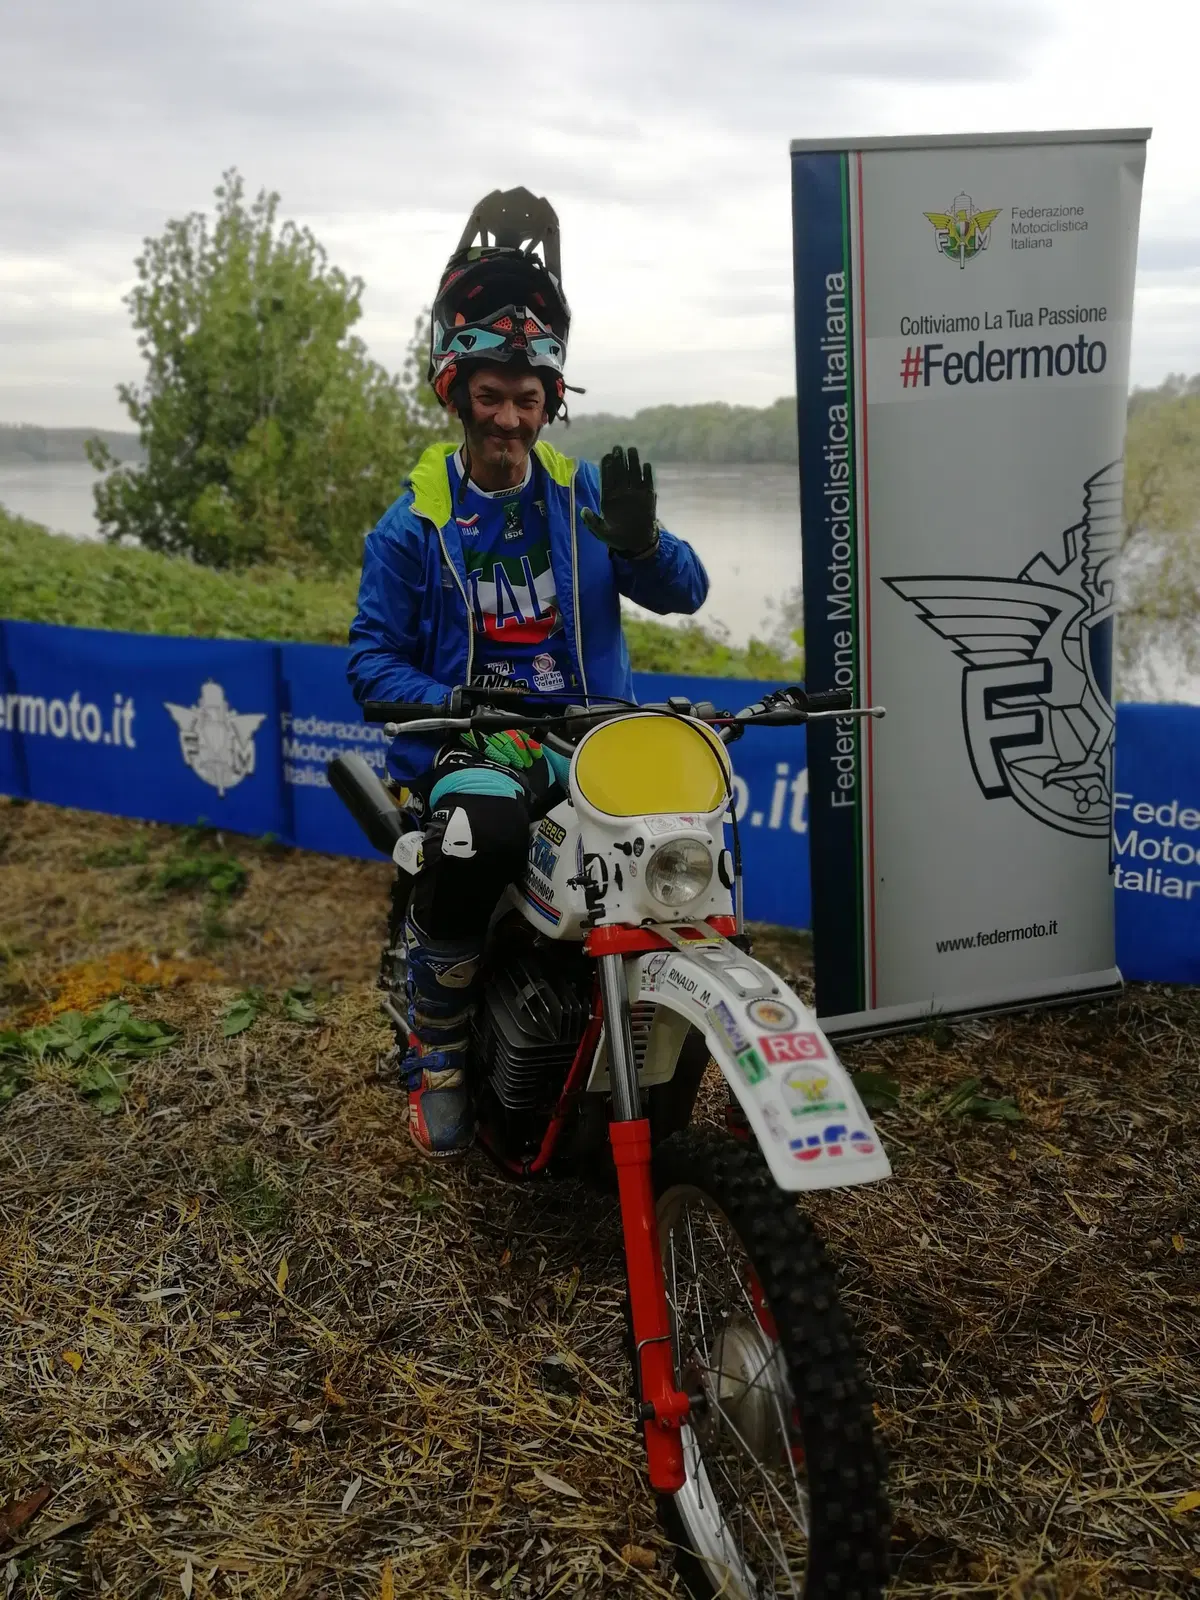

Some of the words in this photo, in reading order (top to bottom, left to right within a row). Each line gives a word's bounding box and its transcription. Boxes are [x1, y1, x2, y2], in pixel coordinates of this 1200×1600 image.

[1011, 204, 1084, 219] Federazione
[1011, 220, 1088, 235] Motociclistica
[1011, 237, 1053, 250] Italiana
[820, 271, 849, 392] Italiana
[900, 311, 980, 336] Coltiviamo
[984, 310, 1003, 330] La
[1006, 309, 1033, 329] Tua
[1038, 304, 1107, 327] Passione
[900, 333, 1107, 388] #Federmoto
[822, 402, 853, 621] Motociclistica
[534, 671, 561, 682] Dall'Era
[536, 678, 563, 687] Valerio
[0, 690, 136, 748] rmoto.it
[281, 712, 394, 745] Federazion
[828, 630, 856, 808] Federaione
[1113, 829, 1200, 866] Moto
[936, 919, 1058, 954] www.federmoto.it
[668, 968, 698, 994] RINALDI
[768, 1035, 819, 1061] RG
